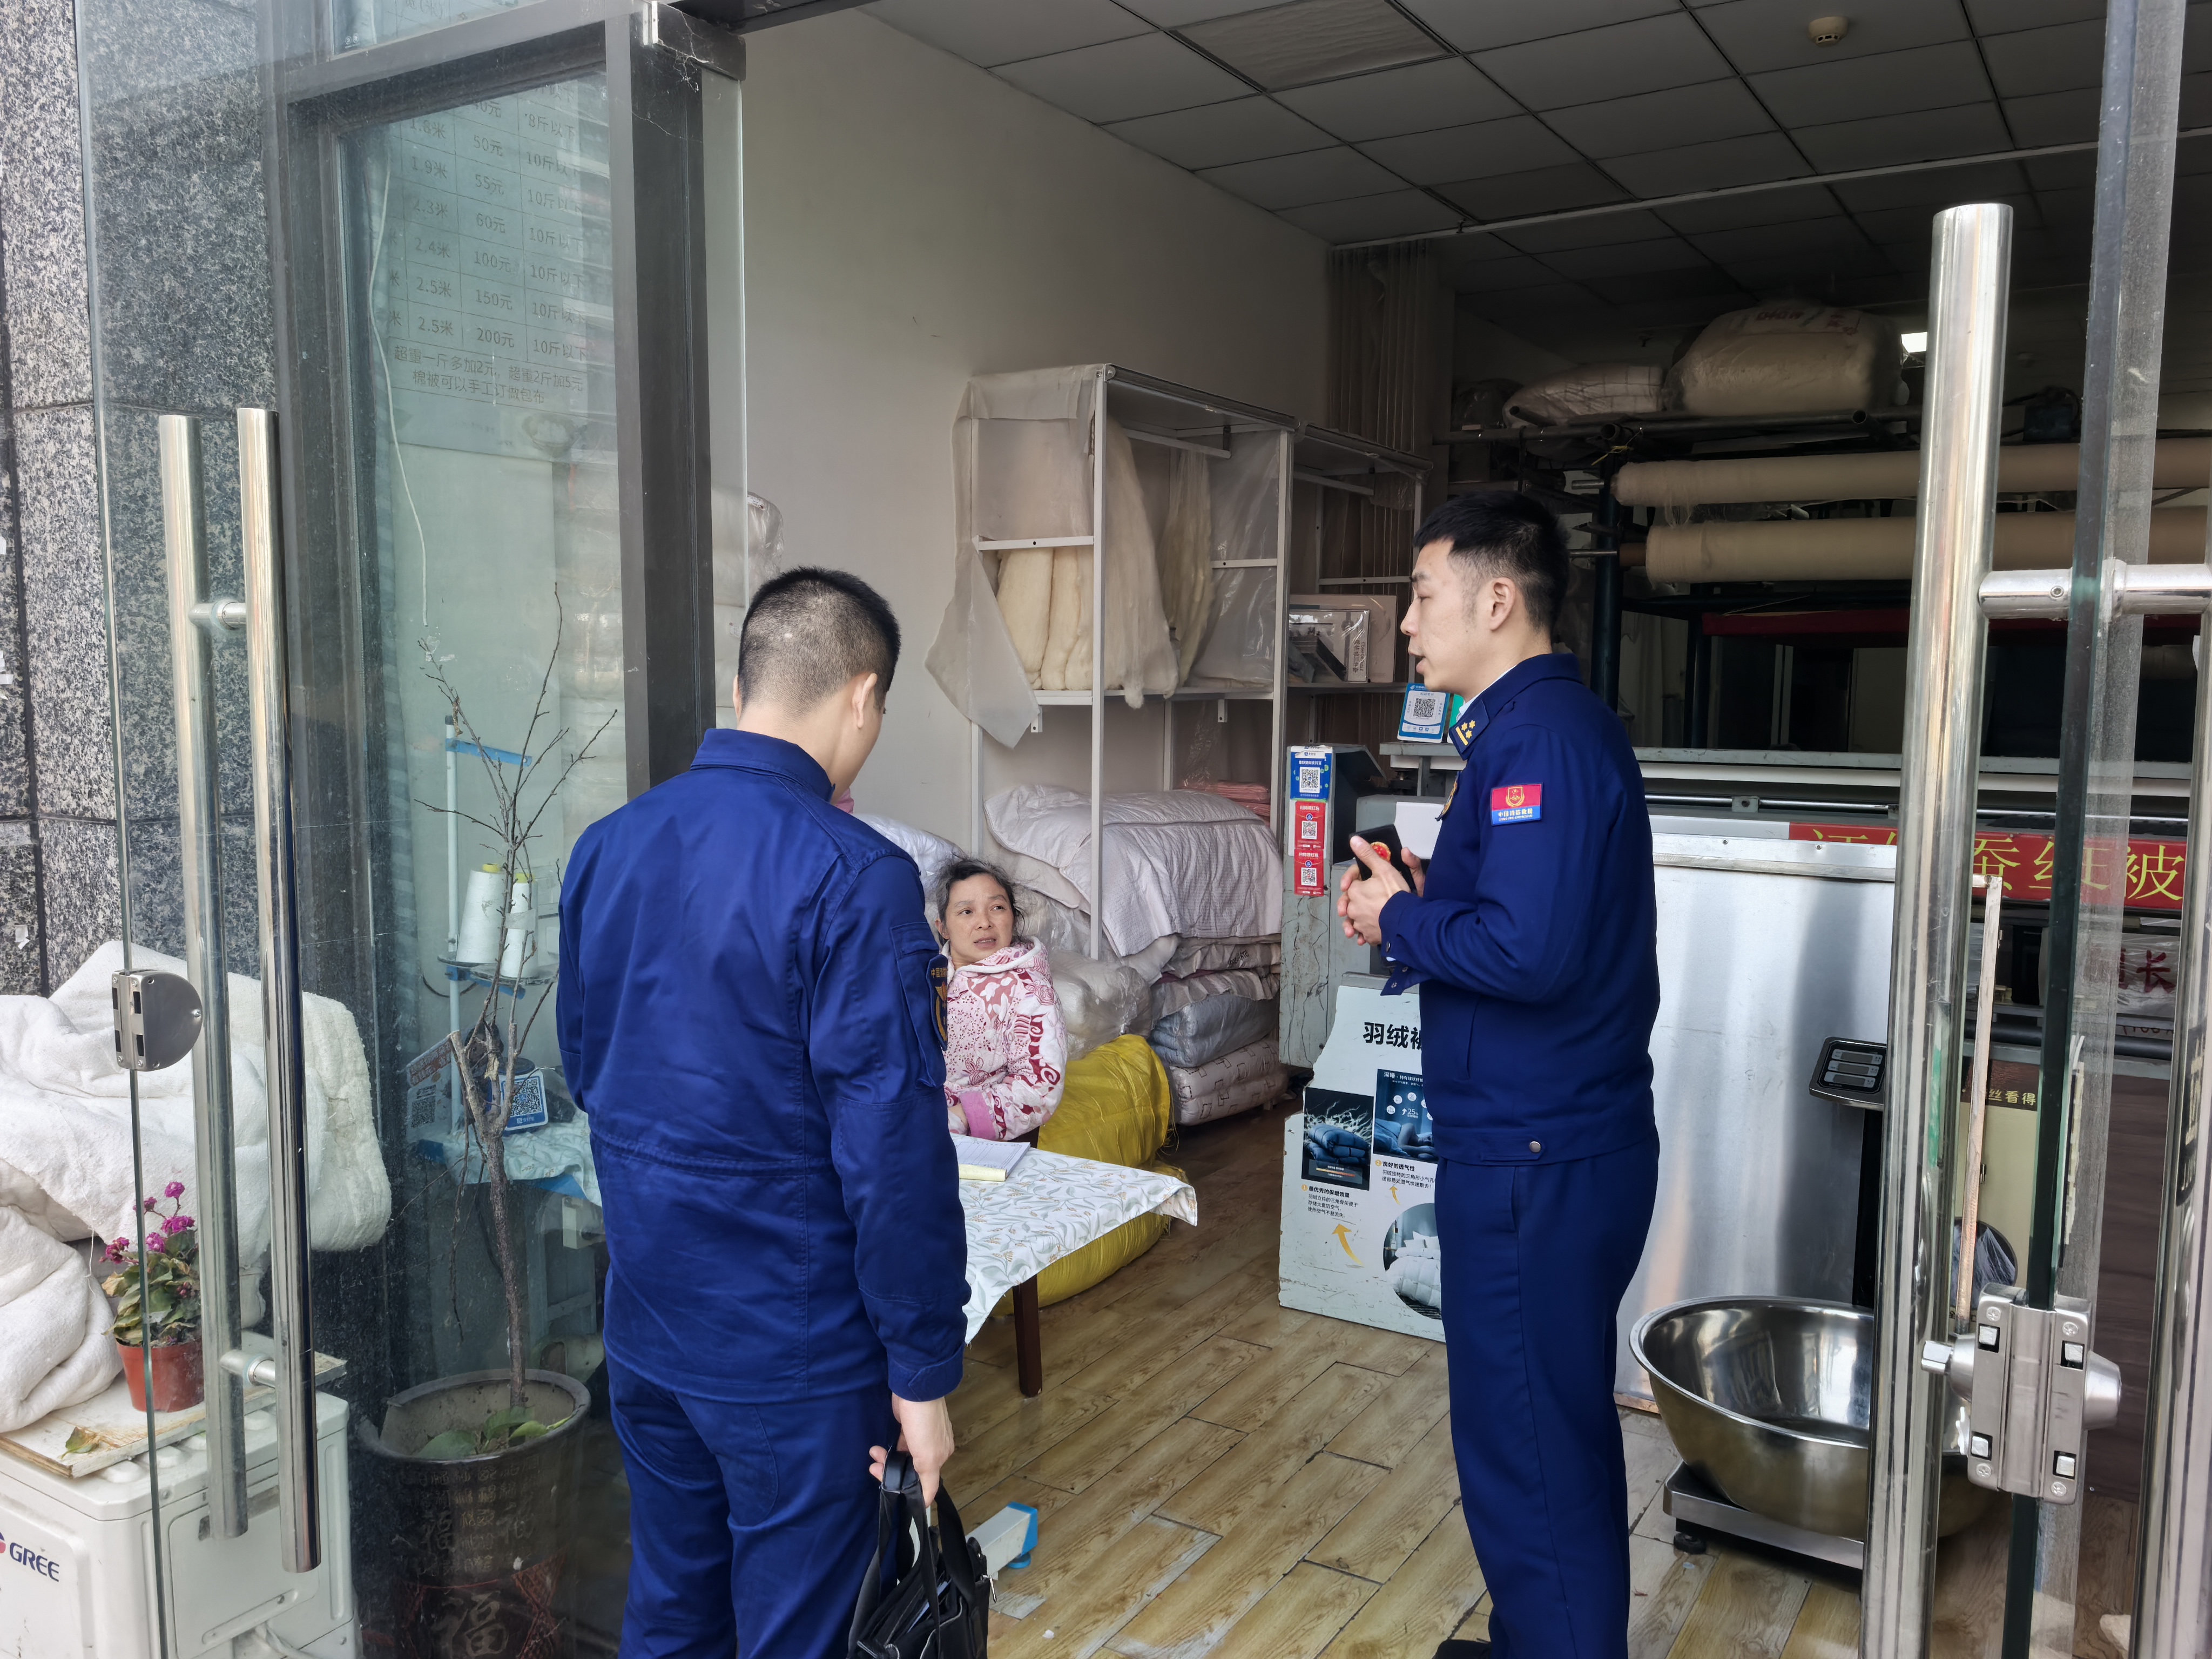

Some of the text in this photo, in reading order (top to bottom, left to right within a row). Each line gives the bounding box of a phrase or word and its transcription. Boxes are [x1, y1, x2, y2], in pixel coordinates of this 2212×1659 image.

[473, 134, 503, 157] 50元
[475, 175, 504, 195] 55元
[476, 213, 506, 233] 60元
[529, 227, 584, 253] 10斤以下
[474, 251, 512, 273] 100元
[530, 265, 584, 289] 10斤以下
[416, 276, 452, 298] 2.5米
[475, 289, 513, 311] 150元
[418, 316, 454, 336] 2.5米
[476, 328, 515, 348] 200元
[533, 339, 587, 361] 10斤以下
[1382, 1161, 1415, 1172] 良好的透气性
[9, 1542, 60, 1582] GREE
